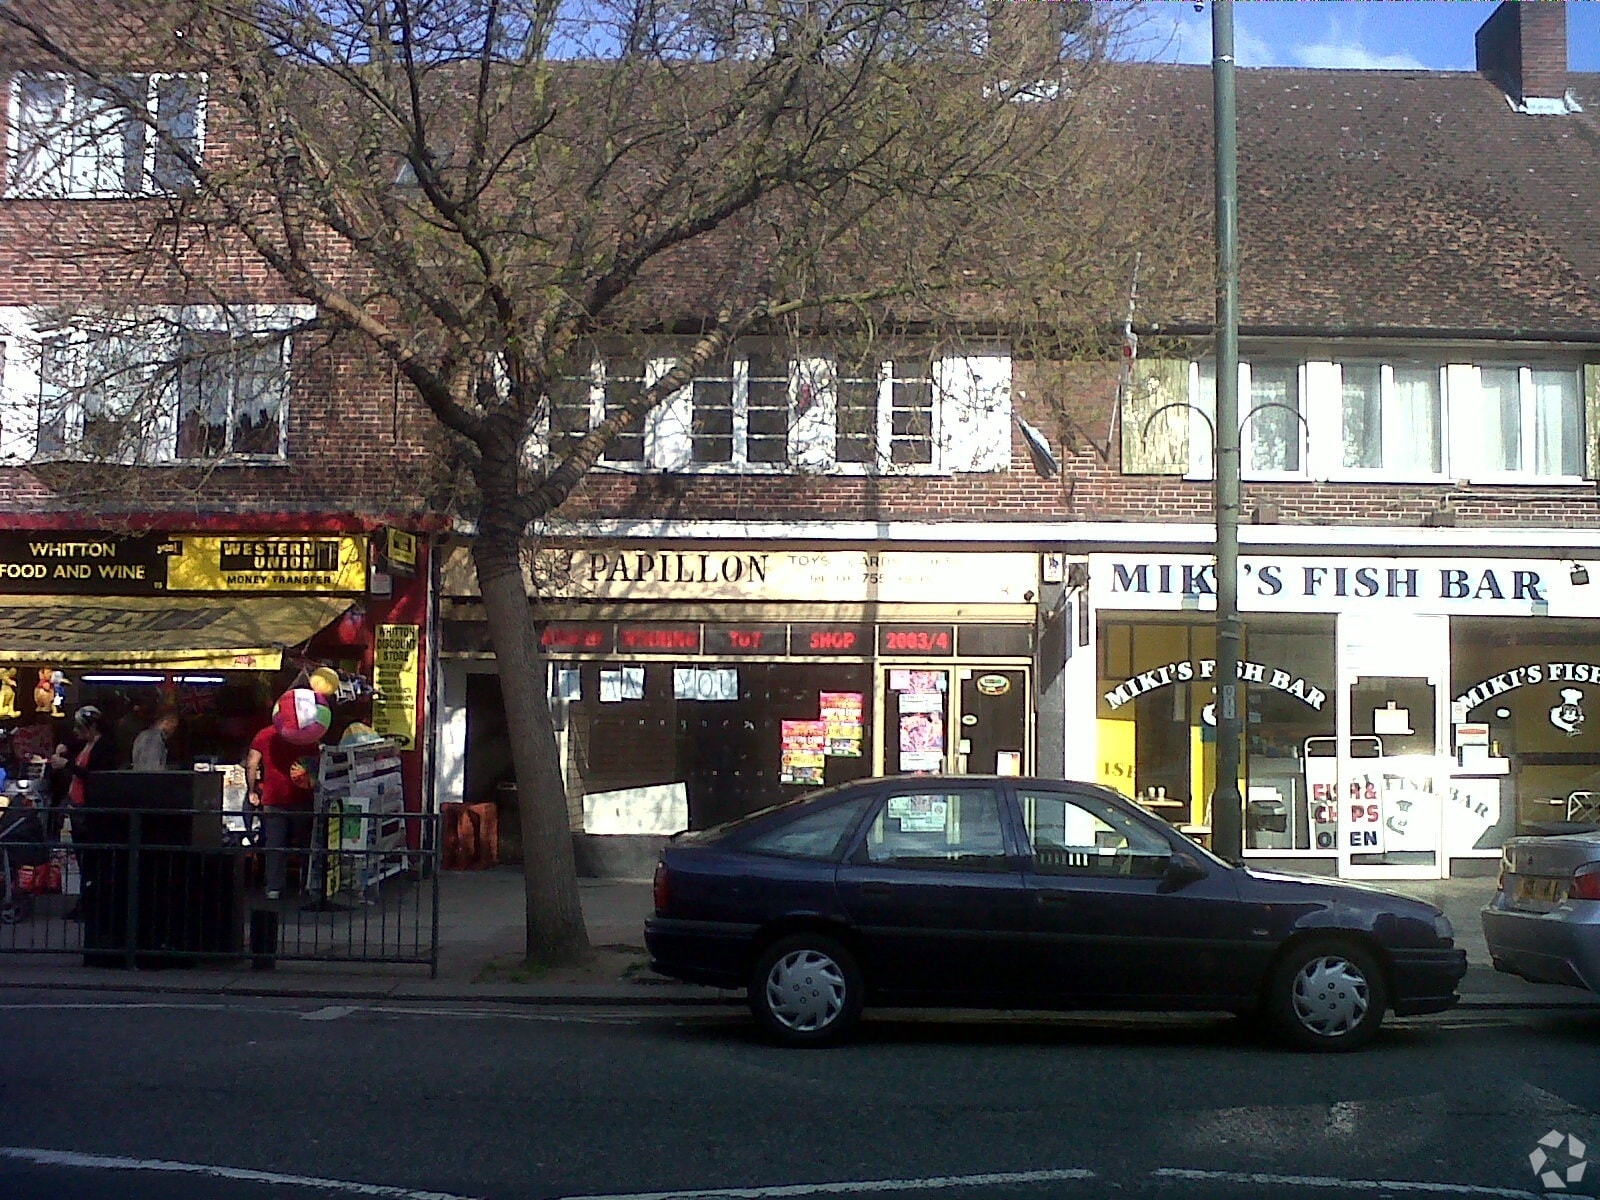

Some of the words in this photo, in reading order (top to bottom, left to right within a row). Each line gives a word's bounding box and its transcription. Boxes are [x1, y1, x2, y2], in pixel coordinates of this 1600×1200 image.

[29, 542, 116, 557] WHITTON
[224, 543, 315, 555] WESTERN
[254, 556, 315, 569] UNION
[587, 553, 769, 583] PAPILLON
[787, 555, 830, 567] TOYS
[0, 564, 47, 578] FOOD
[53, 565, 92, 579] AND
[98, 565, 146, 580] WINE
[227, 575, 267, 585] MONEY
[272, 575, 331, 585] TRANSFER
[1111, 563, 1284, 596] MIK'S
[1301, 566, 1420, 598] FISH
[1438, 569, 1546, 601] BAR
[378, 627, 415, 638] WHITTON
[729, 630, 763, 648] TOY
[810, 631, 856, 649] SHOP
[885, 632, 949, 650] 2003/4
[377, 639, 416, 650] DISCOUNT
[383, 651, 409, 661] STORE
[678, 671, 733, 698] YOU
[1104, 661, 1193, 710] MIKI'S
[1200, 659, 1266, 682] FH
[1269, 668, 1327, 710] BAR
[1456, 665, 1543, 713] MIKI'S
[1314, 804, 1379, 824] CHPS
[1317, 831, 1378, 848] OEN
